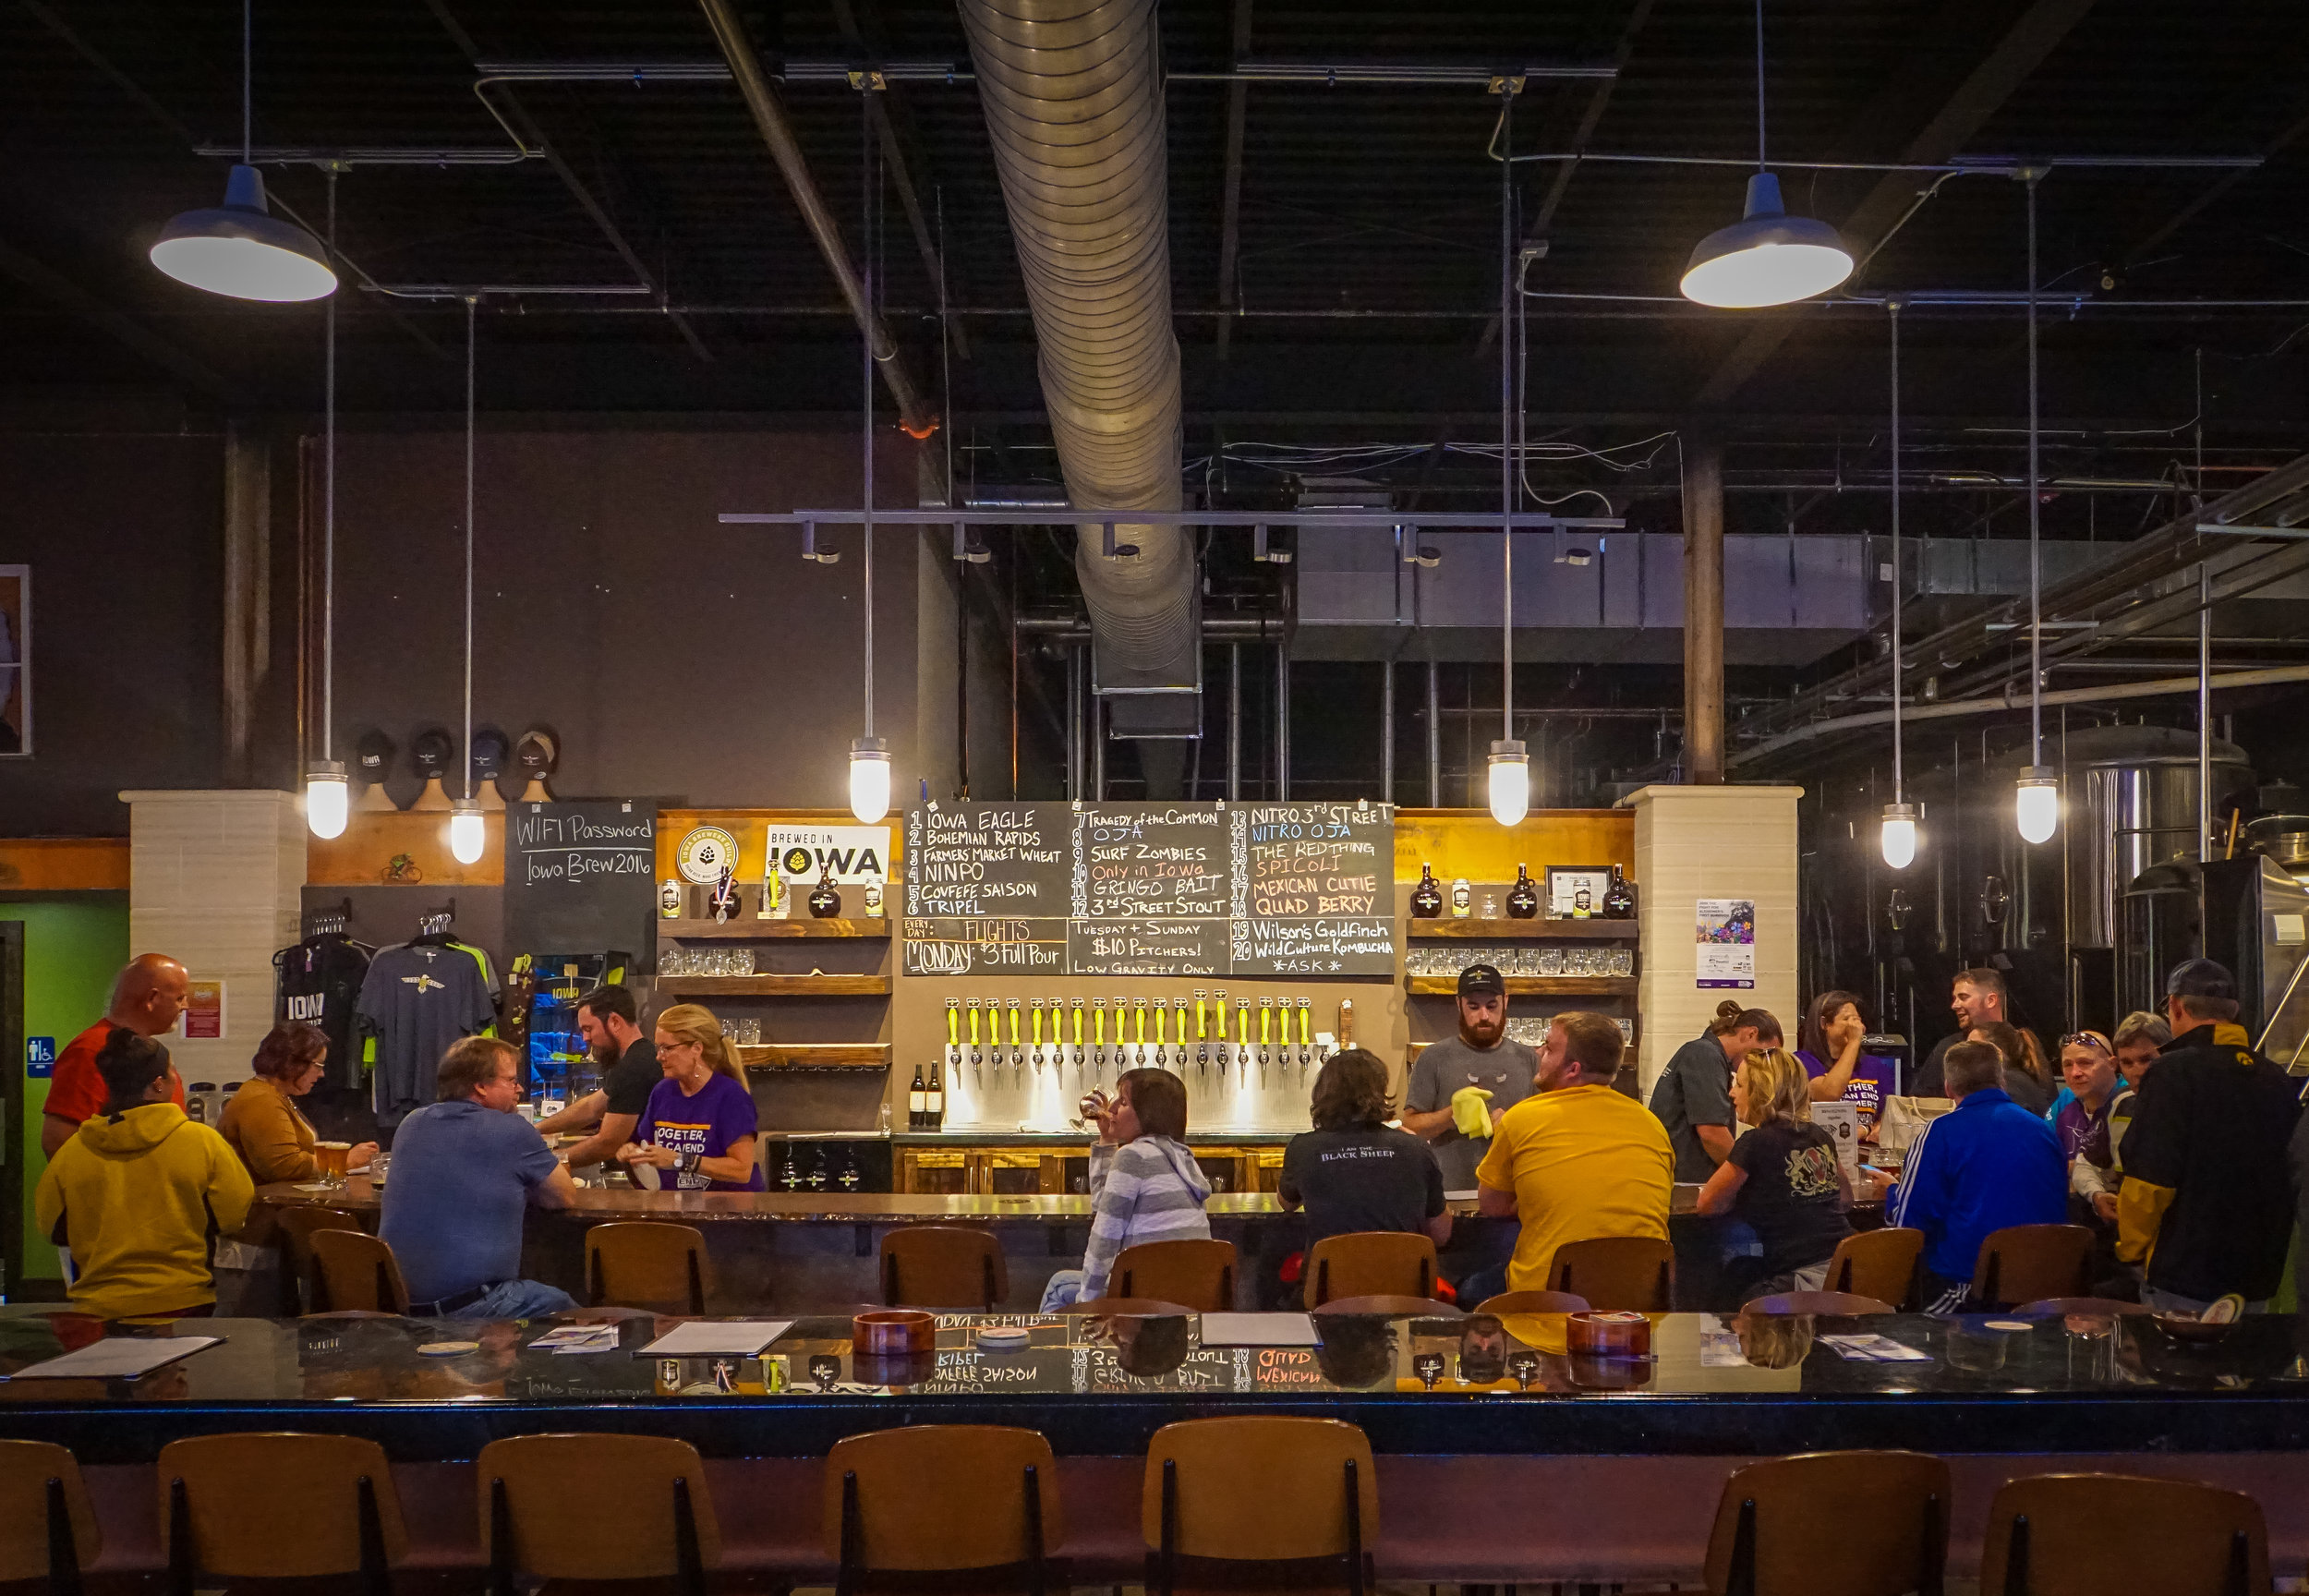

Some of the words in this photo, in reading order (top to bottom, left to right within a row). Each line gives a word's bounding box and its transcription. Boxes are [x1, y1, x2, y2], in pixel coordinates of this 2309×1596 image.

[911, 811, 922, 829] 1
[927, 813, 968, 829] IOWA
[979, 810, 1035, 830] EAGLE
[1074, 812, 1086, 828] 7
[1086, 810, 1132, 828] TRAGEDY
[1133, 813, 1145, 827] of
[1145, 813, 1165, 824] the
[1230, 810, 1247, 829] 13
[1251, 808, 1300, 825] NITRO
[1301, 802, 1327, 824] 3rd
[1327, 803, 1396, 826] STREET
[516, 816, 562, 846] WIFI
[566, 815, 652, 842] Password
[771, 833, 816, 844] BREWED
[822, 834, 833, 844] IN
[909, 830, 922, 846] 2
[926, 830, 987, 846] BOHEMIAN
[994, 830, 1041, 846] RAPIDS
[1071, 828, 1082, 847] 8
[1094, 826, 1144, 841] OJA
[1230, 829, 1247, 848] 14
[1252, 824, 1302, 842] NITRO
[1311, 824, 1351, 839] OJA
[771, 847, 882, 875] IOWA
[909, 849, 919, 866] 3
[973, 847, 1017, 862] MARKET
[1020, 848, 1062, 864] WHEAT
[1072, 847, 1083, 865] 9
[1091, 846, 1130, 862] SURF
[1136, 844, 1207, 861] ZOMBIES
[1231, 847, 1248, 865] 15
[1251, 843, 1287, 861] THE
[1295, 840, 1328, 858] RED
[1328, 842, 1375, 856] THING
[527, 855, 563, 883] Iowa
[908, 867, 919, 884] 4
[925, 863, 985, 882] NINPO
[1071, 864, 1088, 883] 10
[1092, 864, 1129, 880] Only
[1134, 864, 1148, 877] in
[1230, 865, 1249, 884] 16
[1256, 854, 1343, 877] SPICOLI
[908, 885, 921, 901] 5
[921, 884, 978, 900] COVFEFE
[982, 883, 1037, 898] SAISON
[1071, 882, 1087, 900] 11
[1094, 879, 1164, 896] GRINGO
[1175, 874, 1224, 896] BAIT
[1230, 883, 1249, 901] 17
[1253, 877, 1319, 900] MEXICAN
[1326, 876, 1376, 892] CUTIE
[907, 900, 919, 915] 6
[925, 899, 985, 914] TRIPEL
[1071, 900, 1089, 917] 12
[1091, 897, 1119, 915] 3rd
[1120, 897, 1174, 917] STREET
[1175, 896, 1226, 914] STOUT
[1230, 901, 1247, 919] 18
[1255, 898, 1310, 916] QUAD
[1318, 896, 1374, 915] BERRY
[905, 920, 928, 928] EVERY
[964, 921, 1030, 941] FLIGHTS
[1070, 920, 1127, 935] TUESDAY
[1146, 920, 1202, 936] SUNDAY
[1232, 922, 1250, 941] 19
[1252, 921, 1312, 941] Wilson's
[1314, 921, 1389, 941] Goldfinch
[980, 943, 999, 964] $3
[1001, 943, 1024, 965] Full
[1025, 943, 1059, 965] Pour
[1092, 937, 1125, 957] $10
[1130, 937, 1202, 957] PITCHERS!
[1233, 941, 1251, 961] 20
[1255, 942, 1283, 958] Wild
[1074, 960, 1106, 973] LOW
[1111, 962, 1175, 974] GRAVITY
[1183, 962, 1215, 974] ONLY
[551, 987, 580, 999] IOWA
[1860, 1092, 1880, 1101] END
[685, 1143, 705, 1154] END
[1321, 1152, 1358, 1162] BLACK
[1360, 1150, 1395, 1158] SHEEP
